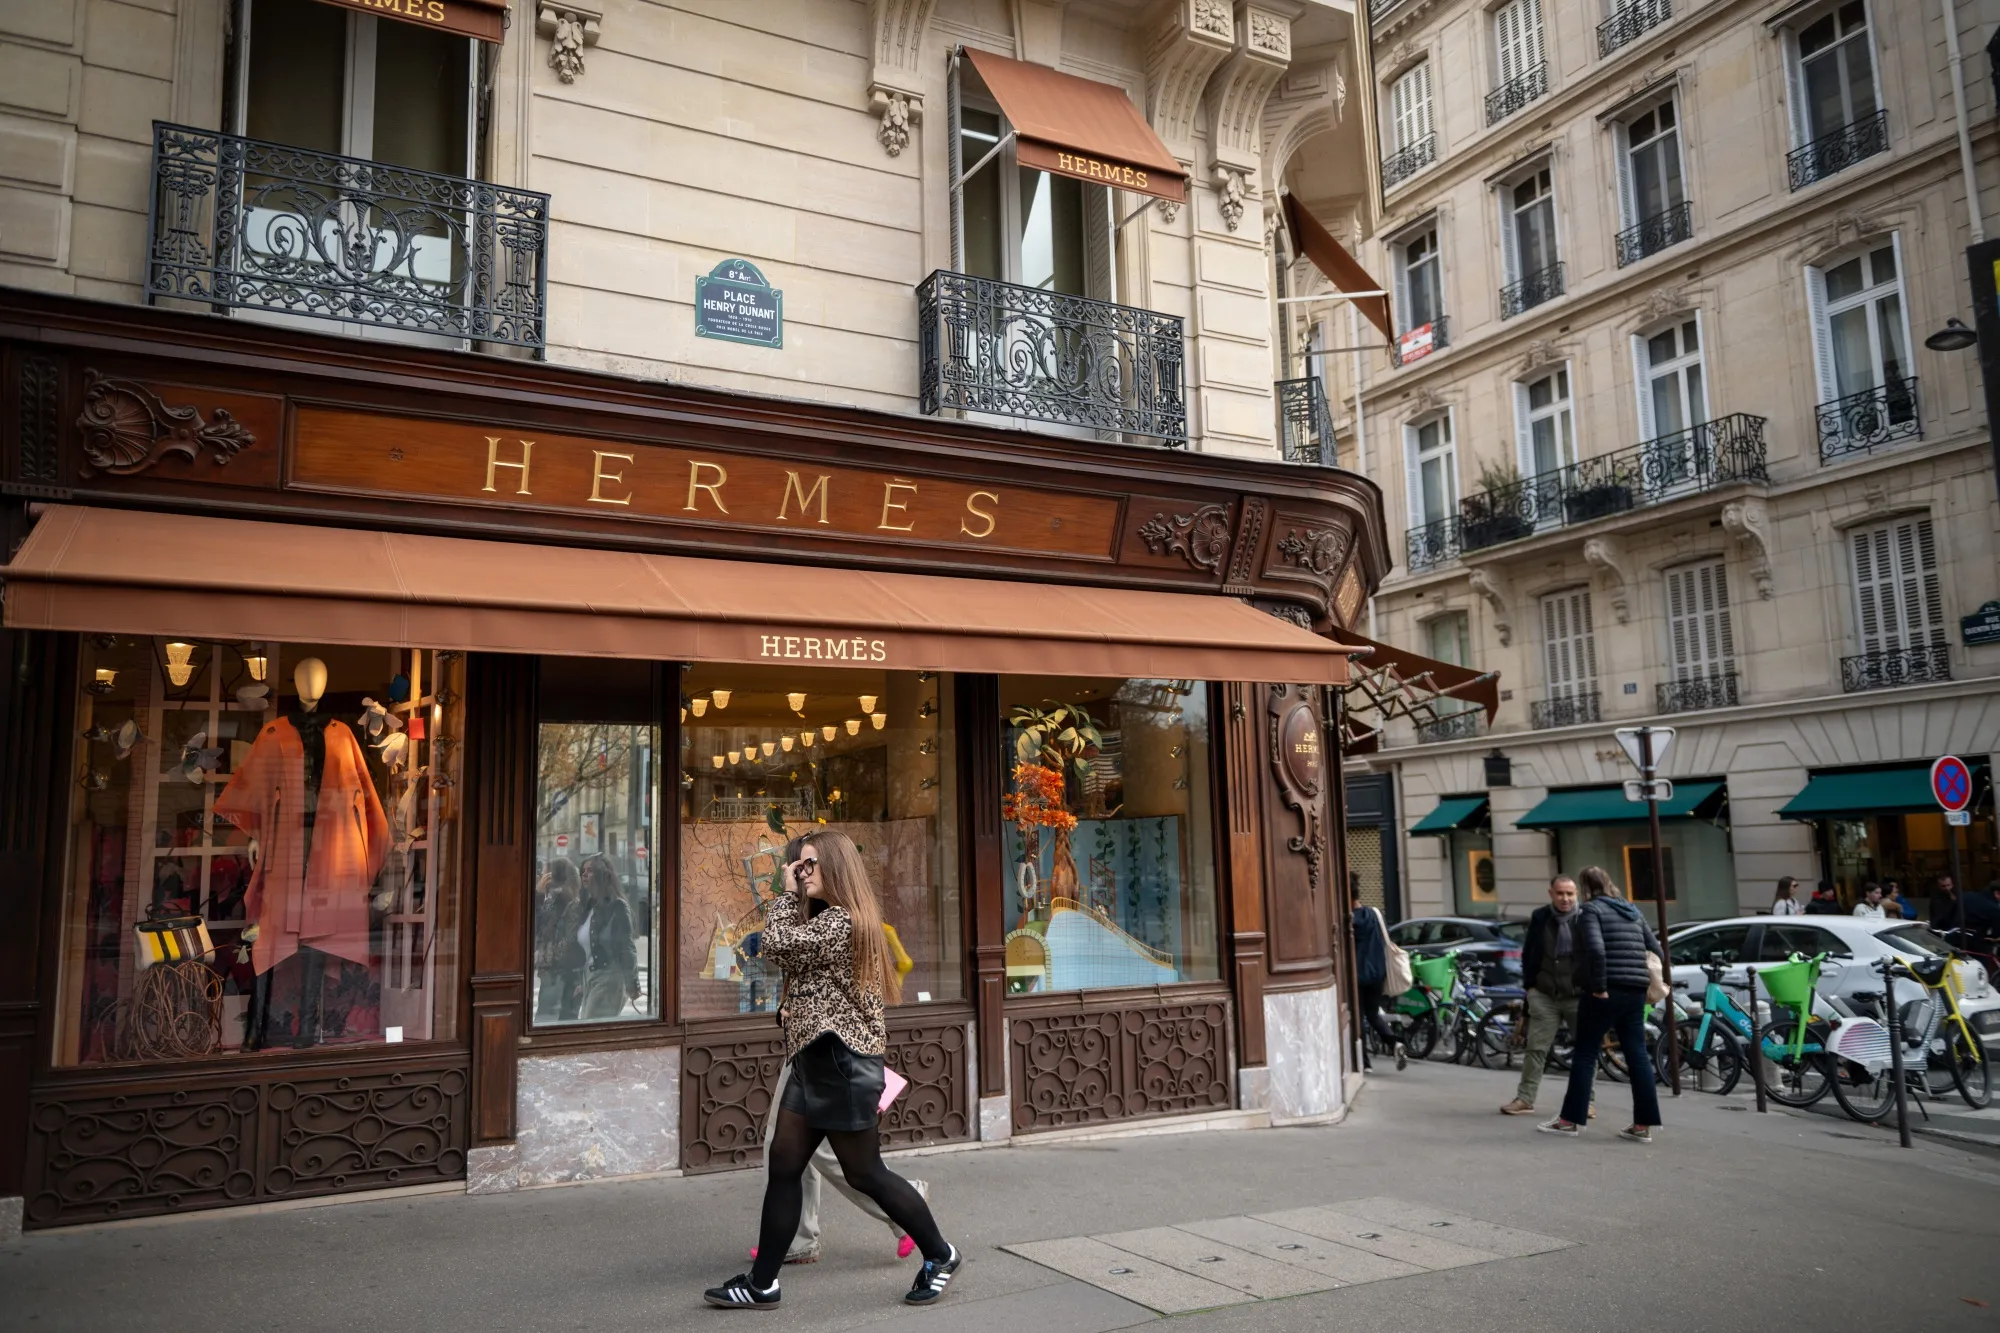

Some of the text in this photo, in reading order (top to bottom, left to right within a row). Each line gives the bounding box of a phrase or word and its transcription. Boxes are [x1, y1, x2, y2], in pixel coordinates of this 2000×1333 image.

[1058, 152, 1148, 188] HERMÈS
[703, 299, 775, 320] HENRY DUNANT
[723, 290, 756, 305] PLACE
[760, 634, 887, 661] HERMÈS
